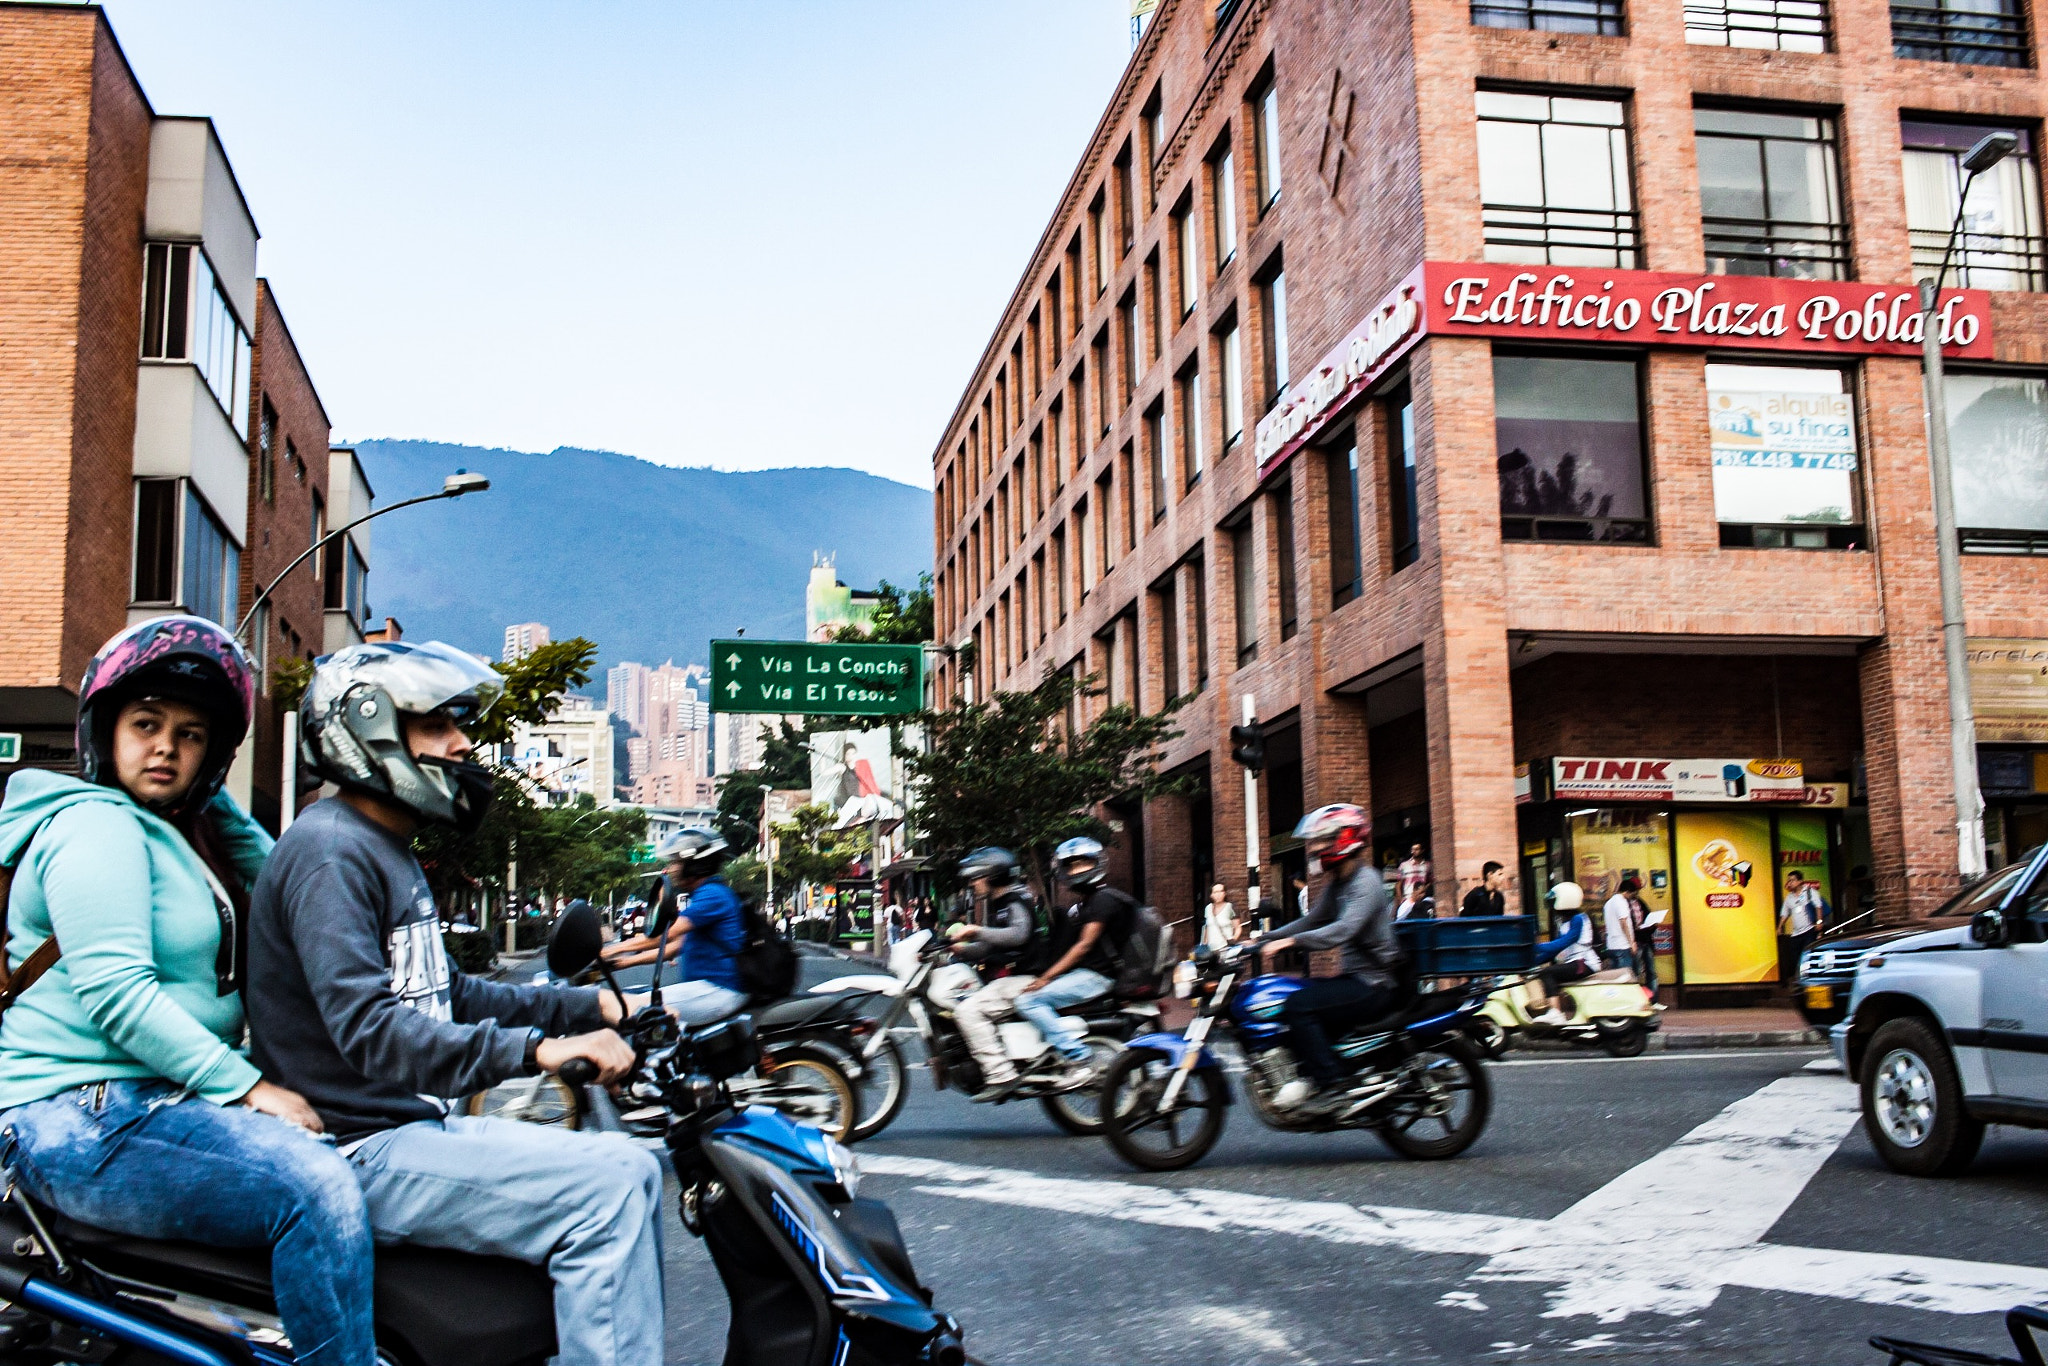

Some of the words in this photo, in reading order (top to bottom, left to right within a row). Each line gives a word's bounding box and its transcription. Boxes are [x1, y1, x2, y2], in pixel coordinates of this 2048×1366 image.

[1444, 272, 1642, 332] Edificio
[1651, 281, 1790, 338] Plaza
[1797, 290, 1981, 346] Poblado
[1767, 393, 1848, 417] alquile
[1768, 420, 1793, 435] su
[1798, 416, 1850, 438] finca
[806, 655, 831, 674] La
[838, 656, 909, 675] Concha
[806, 683, 827, 701] El
[1558, 760, 1672, 781] TINK
